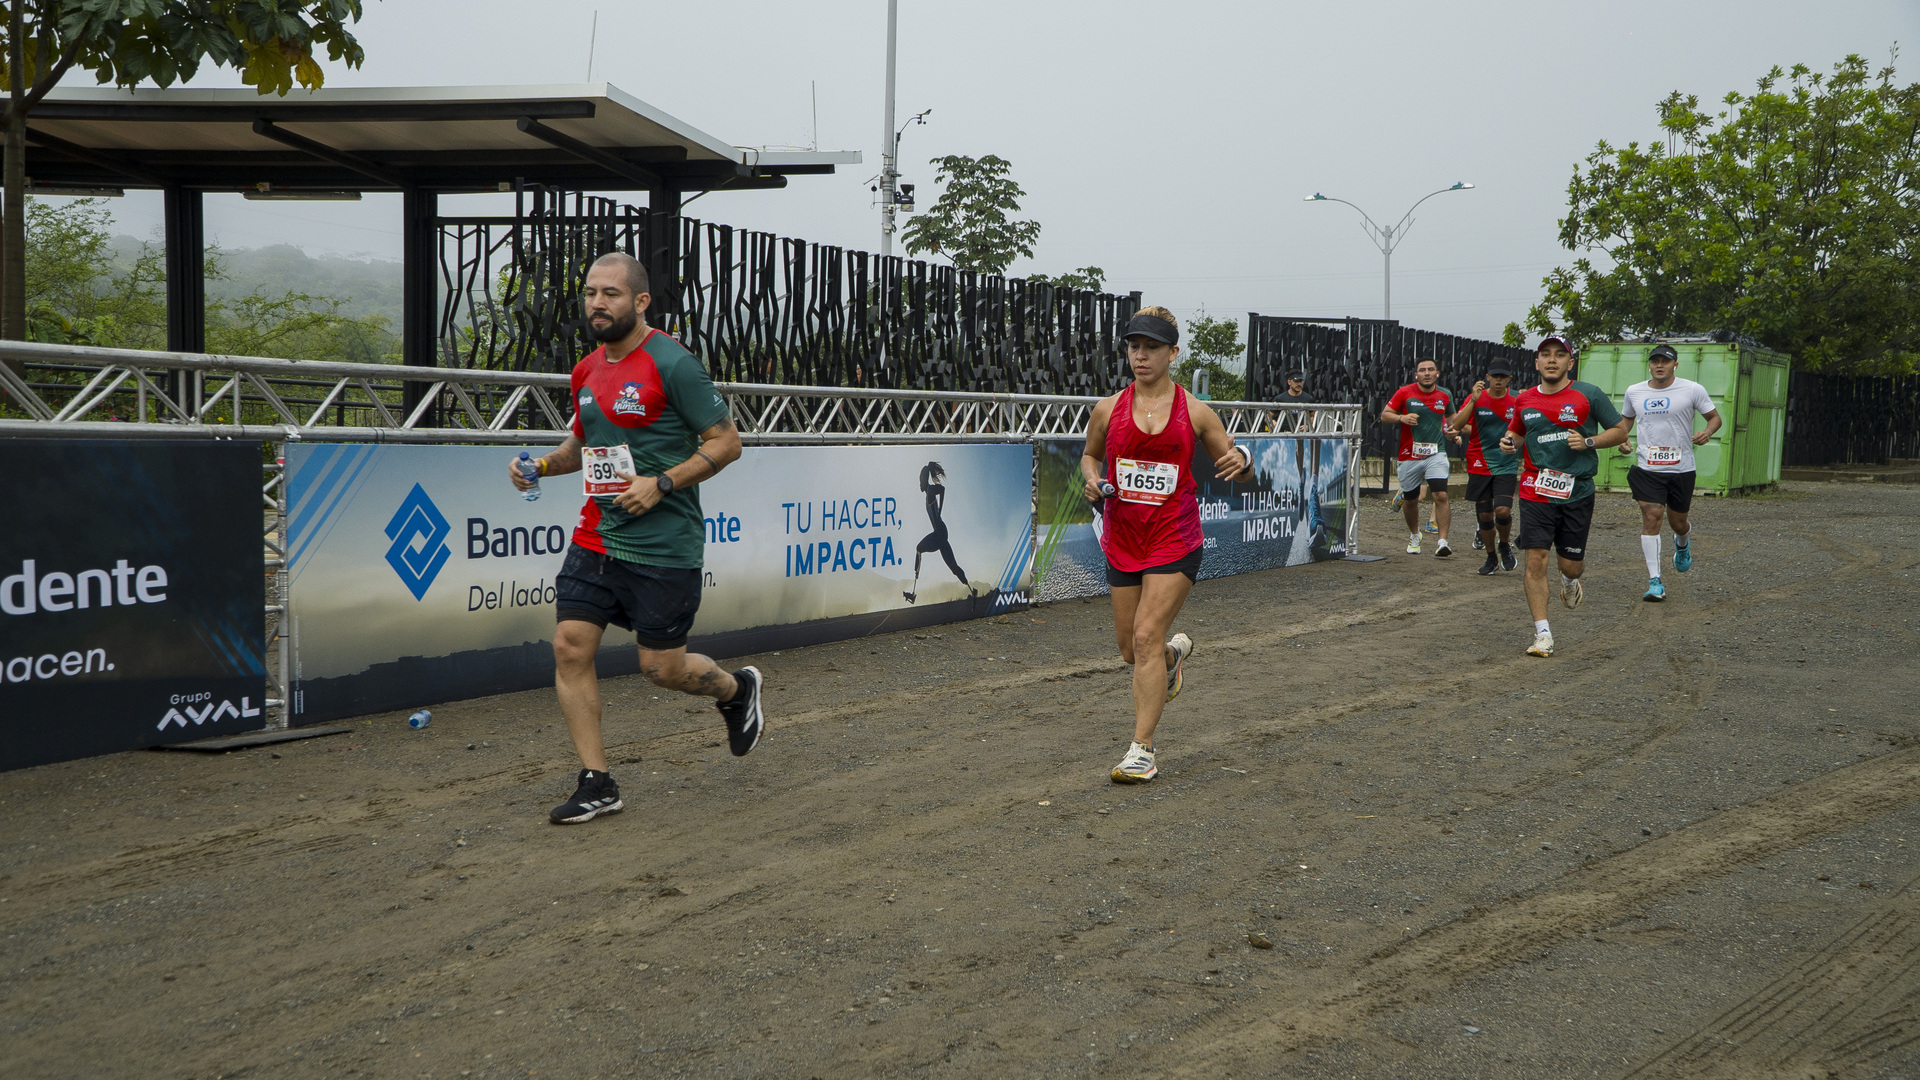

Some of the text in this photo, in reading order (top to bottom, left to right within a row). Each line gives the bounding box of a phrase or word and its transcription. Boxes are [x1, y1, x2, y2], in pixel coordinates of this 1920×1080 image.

[1652, 452, 1675, 460] 1681
[1124, 472, 1166, 492] 1655
[1539, 476, 1566, 491] 1500
[781, 496, 902, 534] TU HACER,
[1241, 489, 1296, 514] TU HACER,
[466, 516, 565, 560] Banco
[1242, 516, 1296, 543] IMPACTA.
[785, 536, 903, 578] IMPACTA.
[0, 559, 168, 616] dente
[468, 581, 504, 612] Del
[510, 578, 556, 608] lado
[995, 591, 1028, 607] AVAL
[169, 691, 212, 706] Grupo
[156, 696, 261, 732] AVAL
